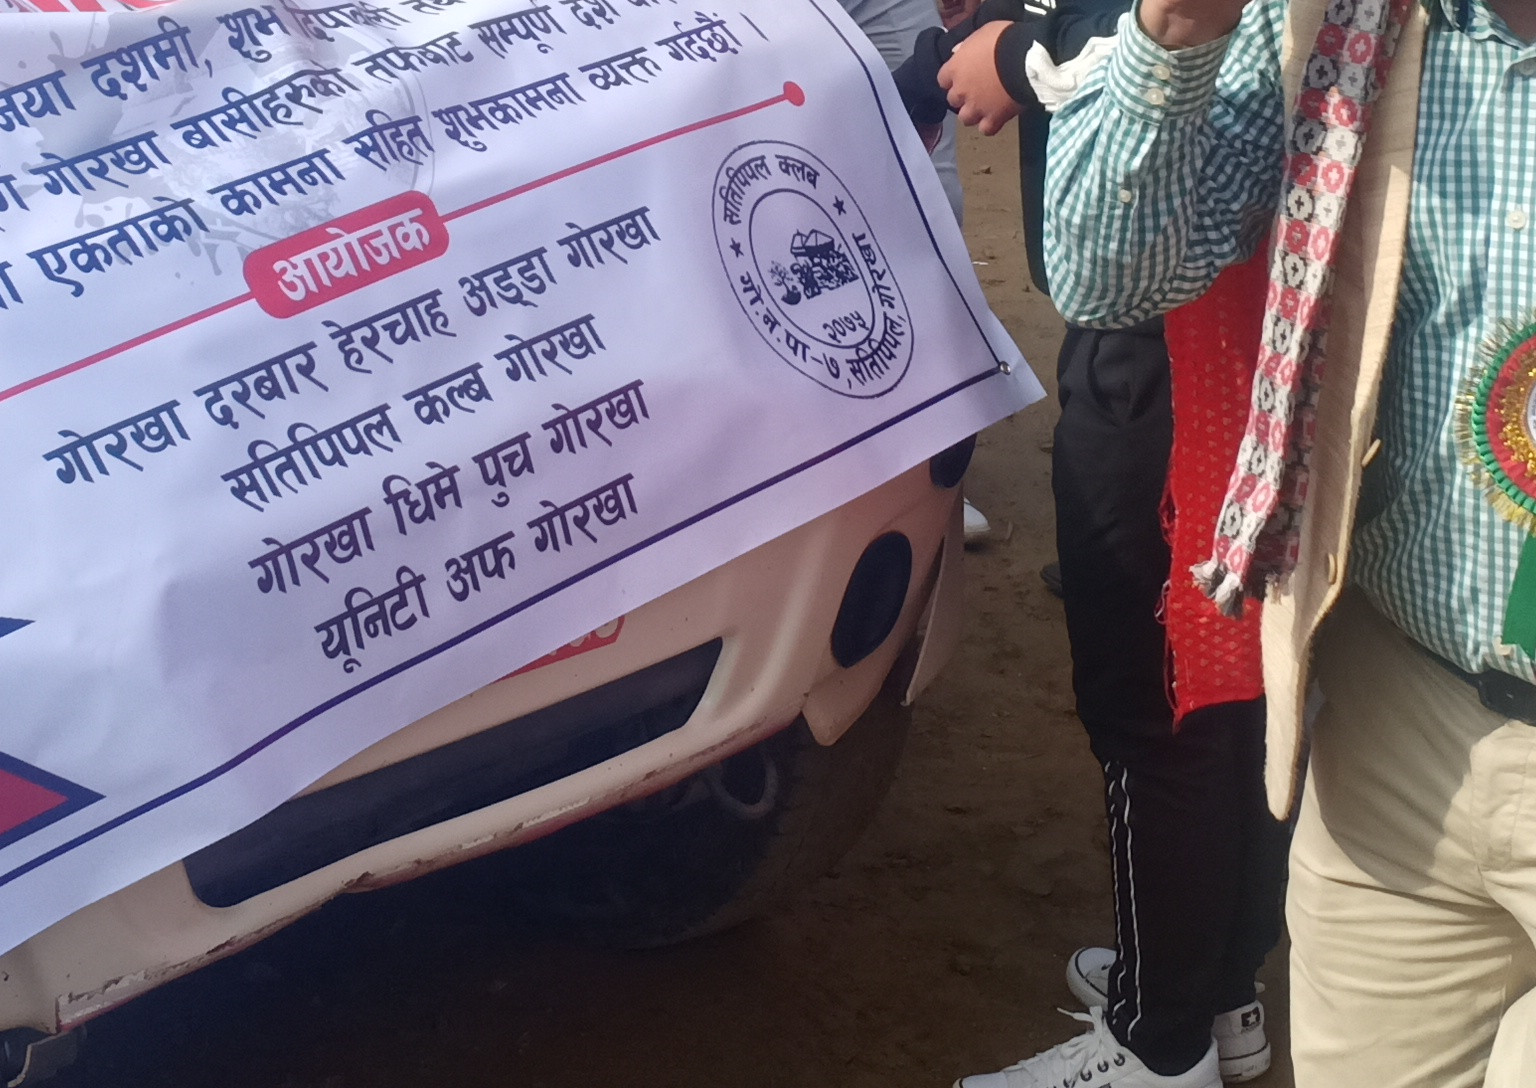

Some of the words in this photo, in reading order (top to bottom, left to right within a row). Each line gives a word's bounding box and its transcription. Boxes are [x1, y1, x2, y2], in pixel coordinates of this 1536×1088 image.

[29, 130, 172, 197] गोरखा
[170, 62, 360, 150] बासीहरुको
[81, 17, 213, 101] दशमी,
[217, 5, 290, 63] शुभ
[26, 196, 209, 298] एकताको
[207, 147, 346, 216] कामना
[342, 108, 435, 170] सहित
[432, 71, 587, 153] शुभकामना
[577, 46, 663, 90] व्यक्त
[271, 208, 431, 302] आयोजक
[719, 155, 771, 225] सतिपिपल
[775, 154, 820, 189] क्लब
[42, 398, 192, 486] गोरखा
[194, 341, 330, 430] दरबार
[321, 288, 458, 374] हेरचाह
[557, 205, 661, 271] गोरखा
[221, 401, 402, 512] सतिपिपल
[403, 362, 493, 427] कल्ब
[494, 313, 606, 383] गोरखा
[248, 506, 376, 596] गोरखा
[382, 461, 463, 535] धिमे
[472, 431, 533, 508] पुच
[542, 379, 651, 456] गोरखा
[315, 565, 431, 673] यूनिटी
[445, 531, 516, 603] अफ
[527, 473, 638, 554] गोरखा
